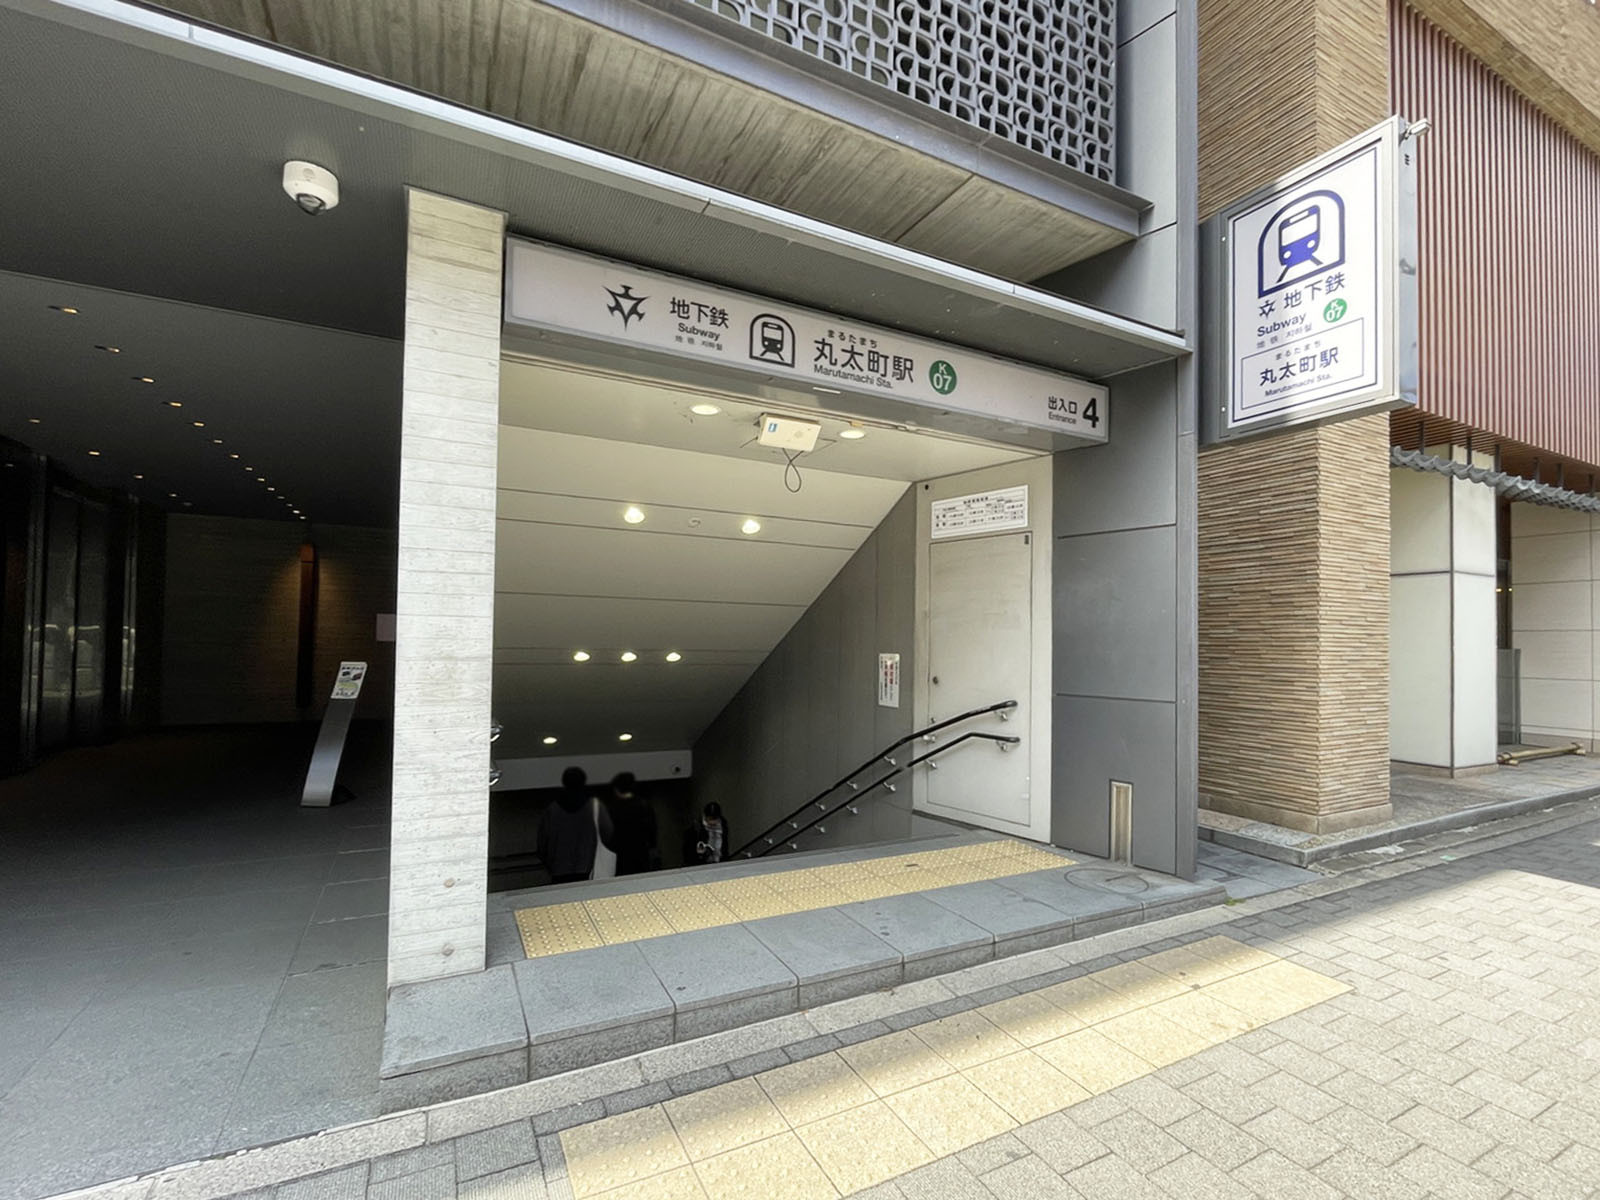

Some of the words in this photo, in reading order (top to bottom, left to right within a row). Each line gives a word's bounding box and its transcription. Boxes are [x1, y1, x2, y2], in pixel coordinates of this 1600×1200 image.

[1284, 272, 1345, 309] 地下鉄
[670, 297, 729, 329] 地下鉄
[1326, 306, 1345, 321] 07
[678, 322, 720, 341] Subway
[1257, 313, 1306, 337] Subway
[828, 329, 878, 348] まるたまち
[813, 338, 914, 383] 丸太町駅
[939, 363, 947, 374] K
[1260, 346, 1339, 387] 丸太町駅
[814, 364, 875, 385] Marutamachi
[876, 377, 893, 389] Sta.
[932, 373, 952, 391] 07
[1265, 379, 1315, 397] Marutamachi
[1048, 396, 1077, 414] 出入口
[1083, 398, 1099, 428] 4
[1048, 411, 1077, 424] Entrance
